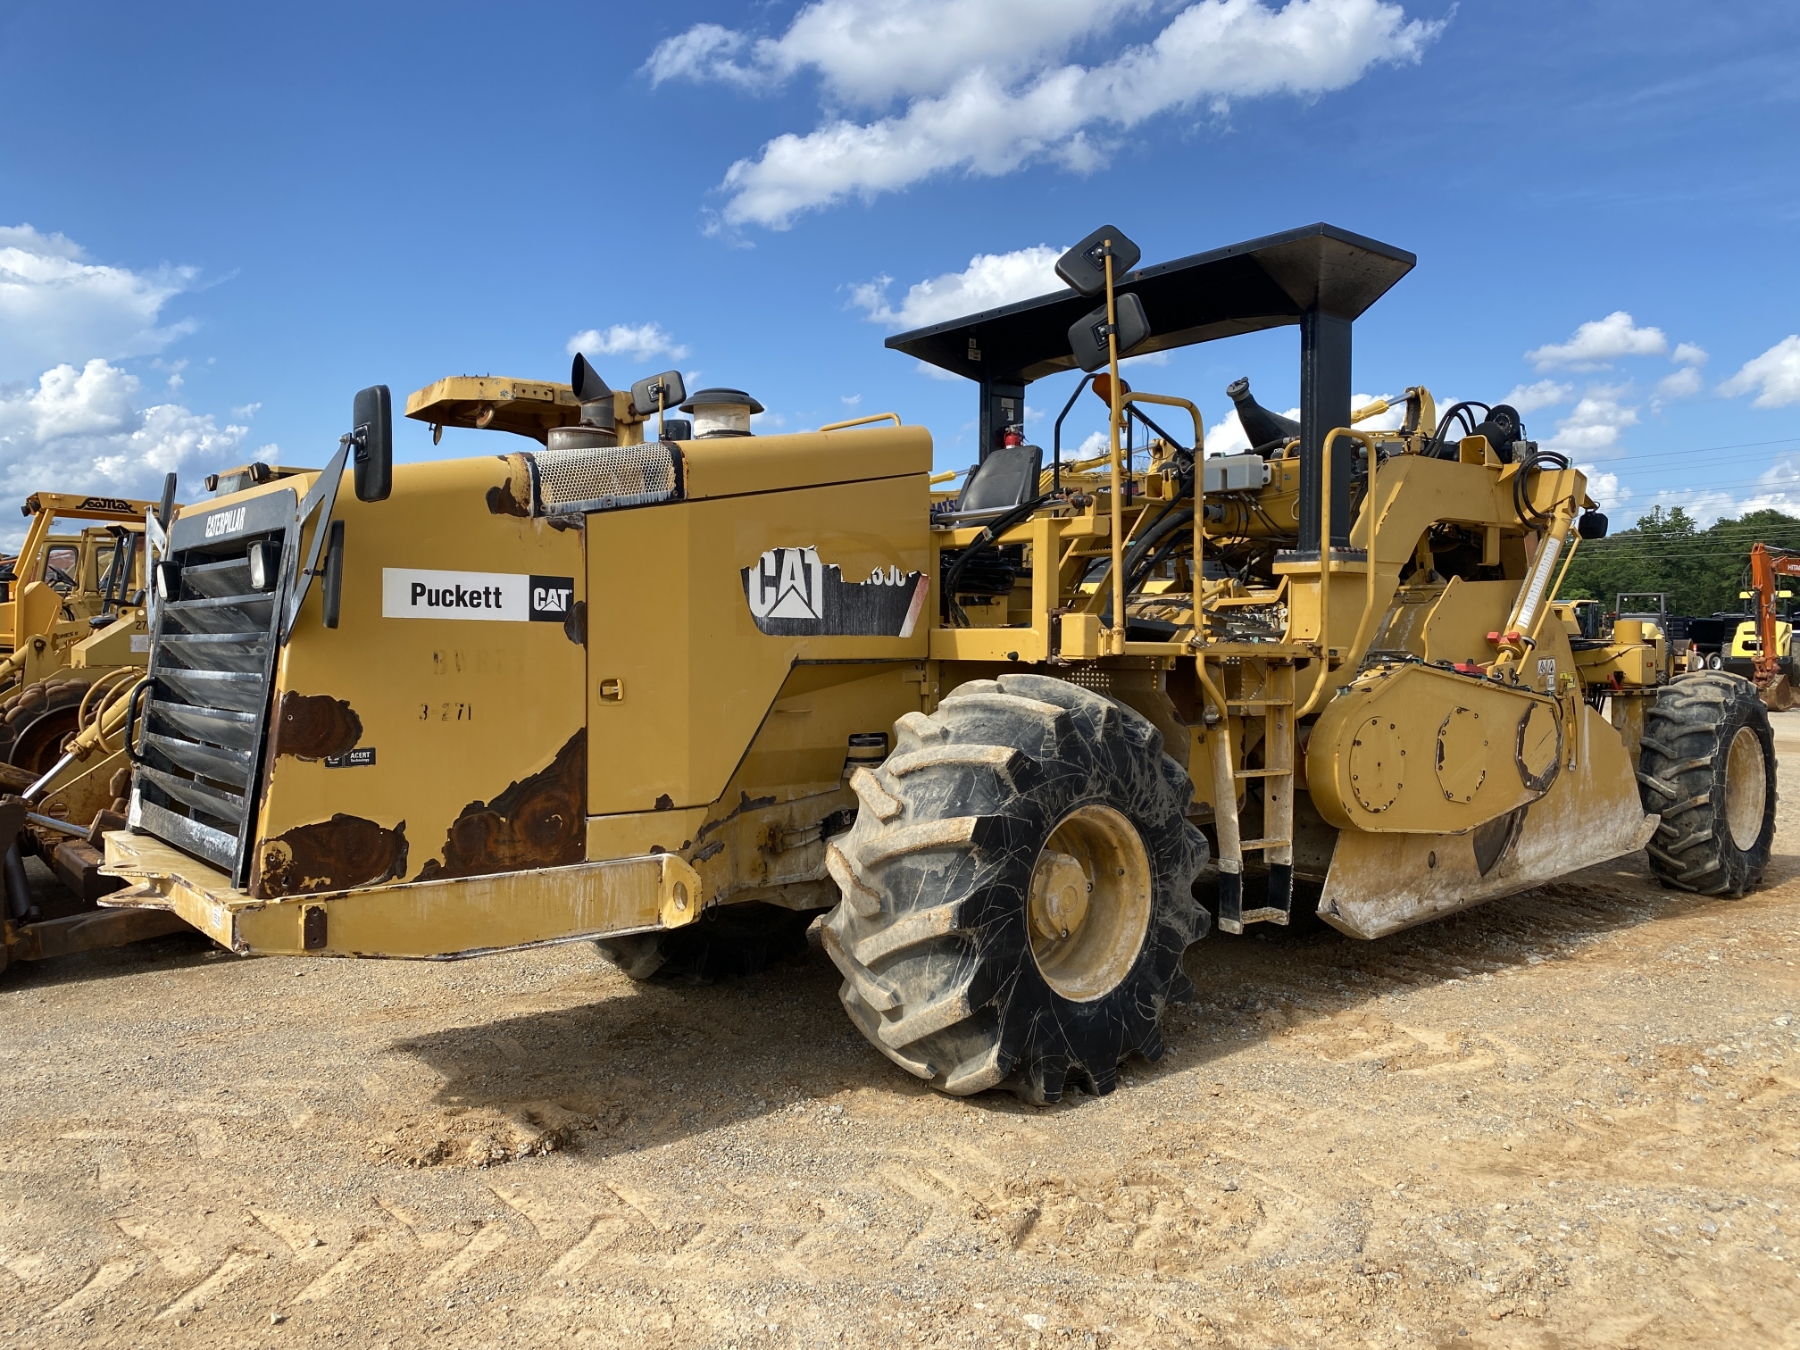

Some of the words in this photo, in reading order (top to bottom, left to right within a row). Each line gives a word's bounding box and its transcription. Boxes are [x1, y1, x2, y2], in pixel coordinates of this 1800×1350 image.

[205, 506, 246, 538] CATERPILLAR
[411, 582, 502, 609] Puckett
[533, 587, 570, 612] CAT
[749, 548, 823, 619] CAT
